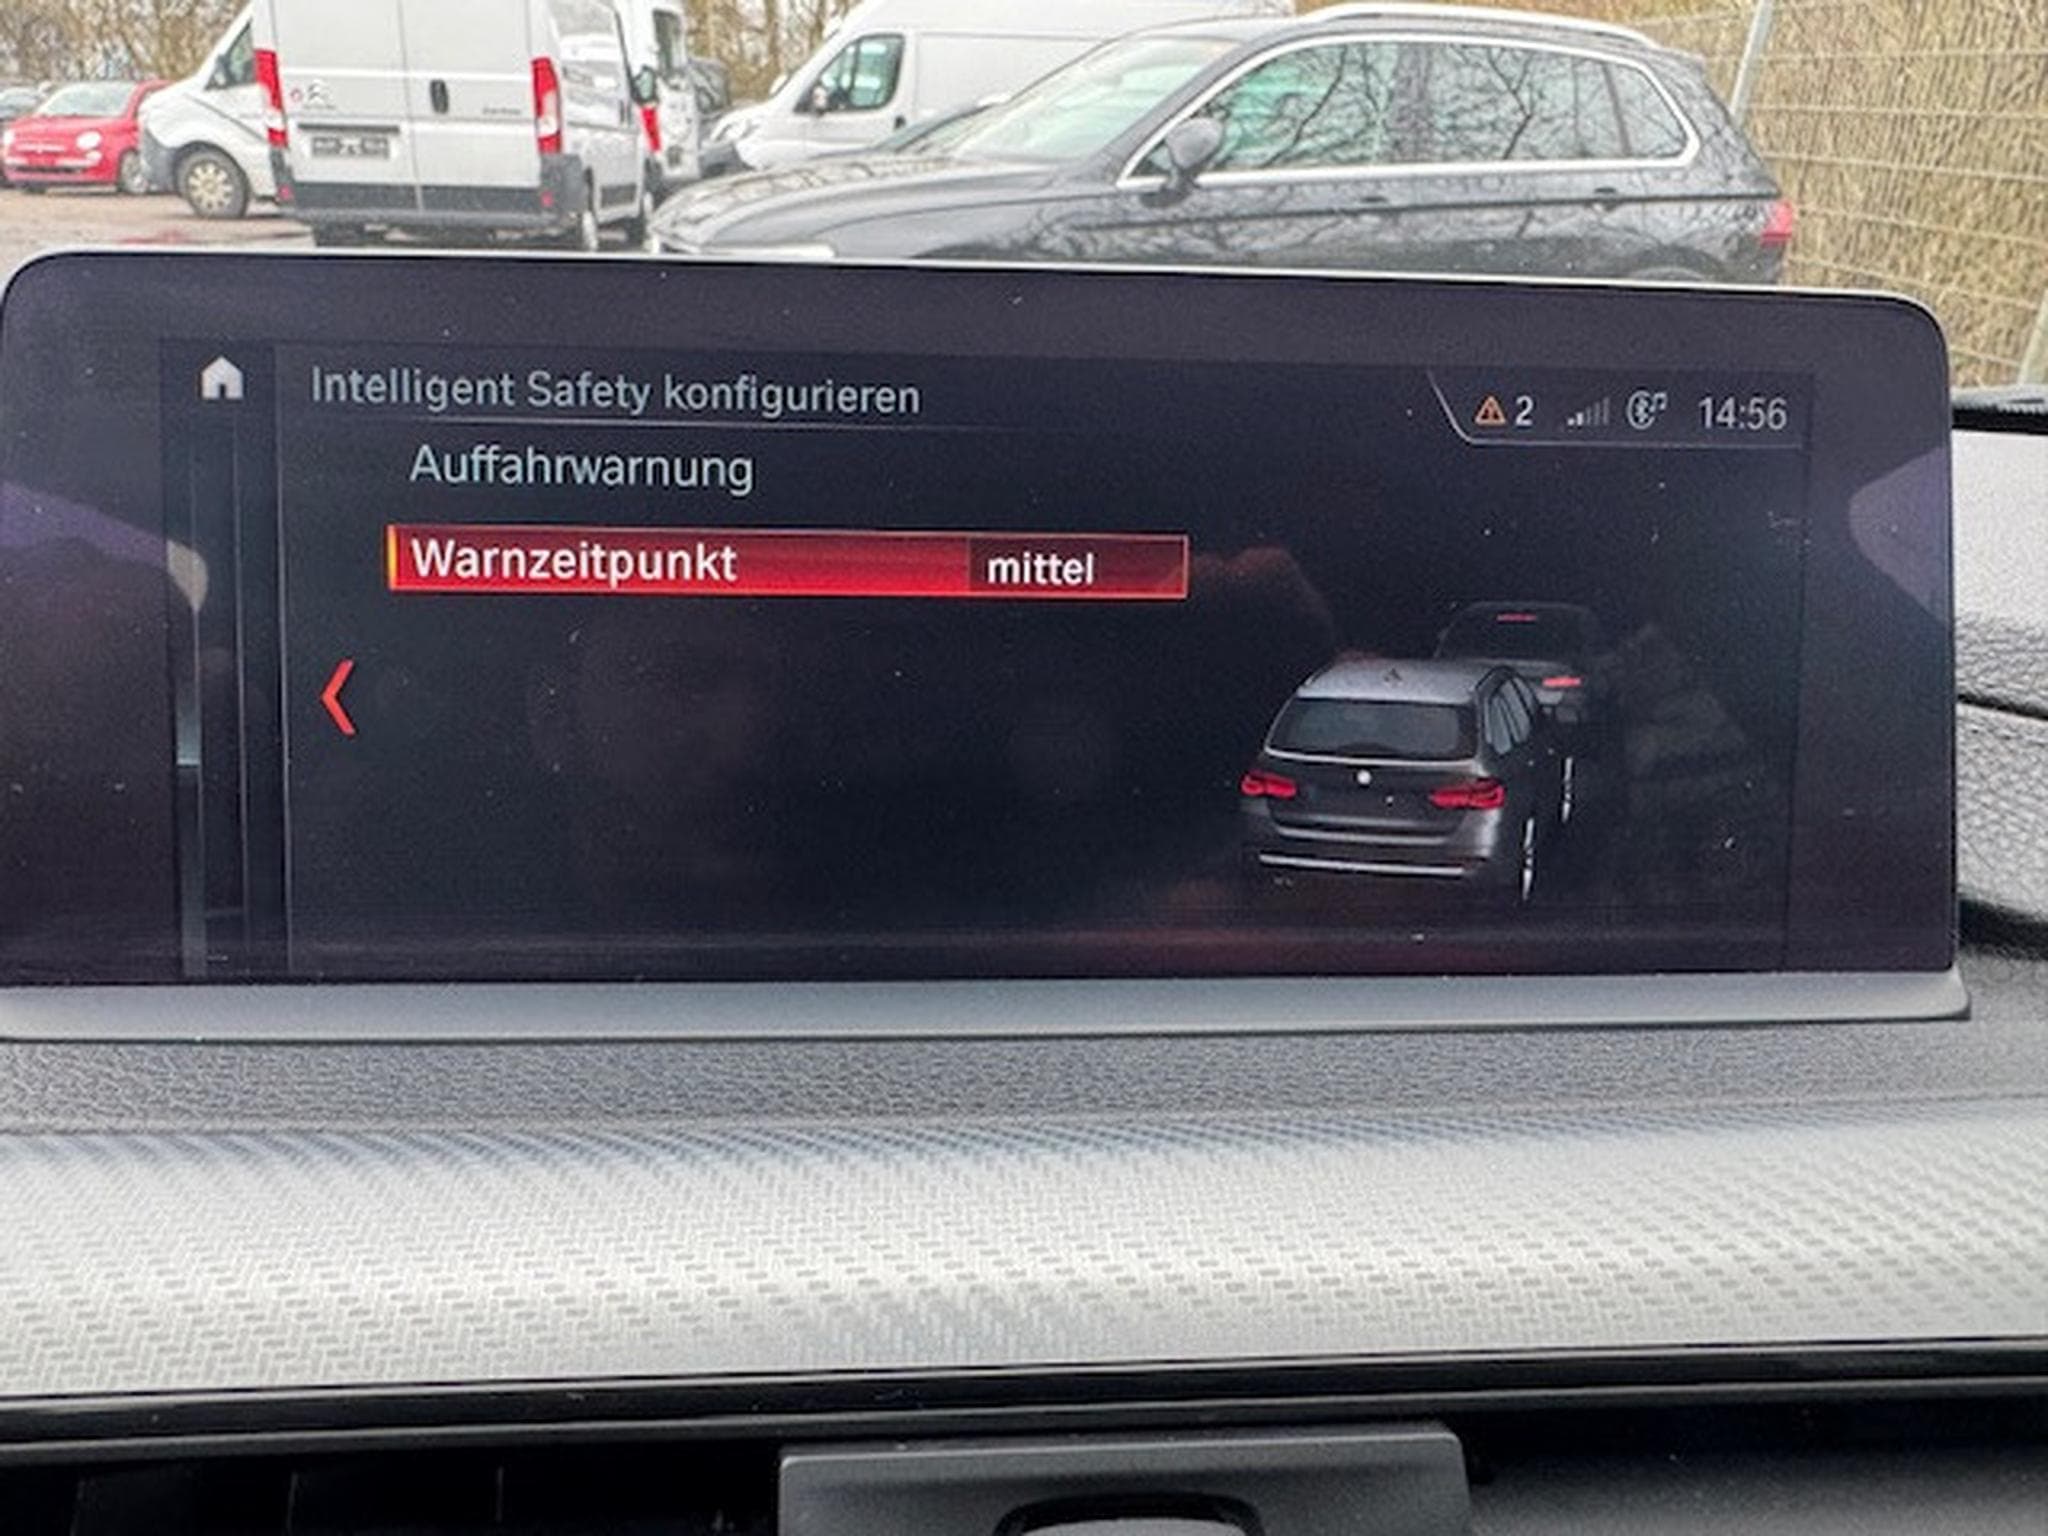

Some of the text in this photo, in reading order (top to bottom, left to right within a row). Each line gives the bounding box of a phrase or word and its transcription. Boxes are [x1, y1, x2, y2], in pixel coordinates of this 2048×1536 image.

[311, 366, 921, 417] Intelligent Safety konfigurieren
[1514, 395, 1534, 427] 2
[1698, 396, 1788, 430] 14:56
[409, 444, 755, 495] Auffahrwarnung
[410, 538, 739, 590] Warnzeitpunkt
[986, 551, 1096, 586] mittel
